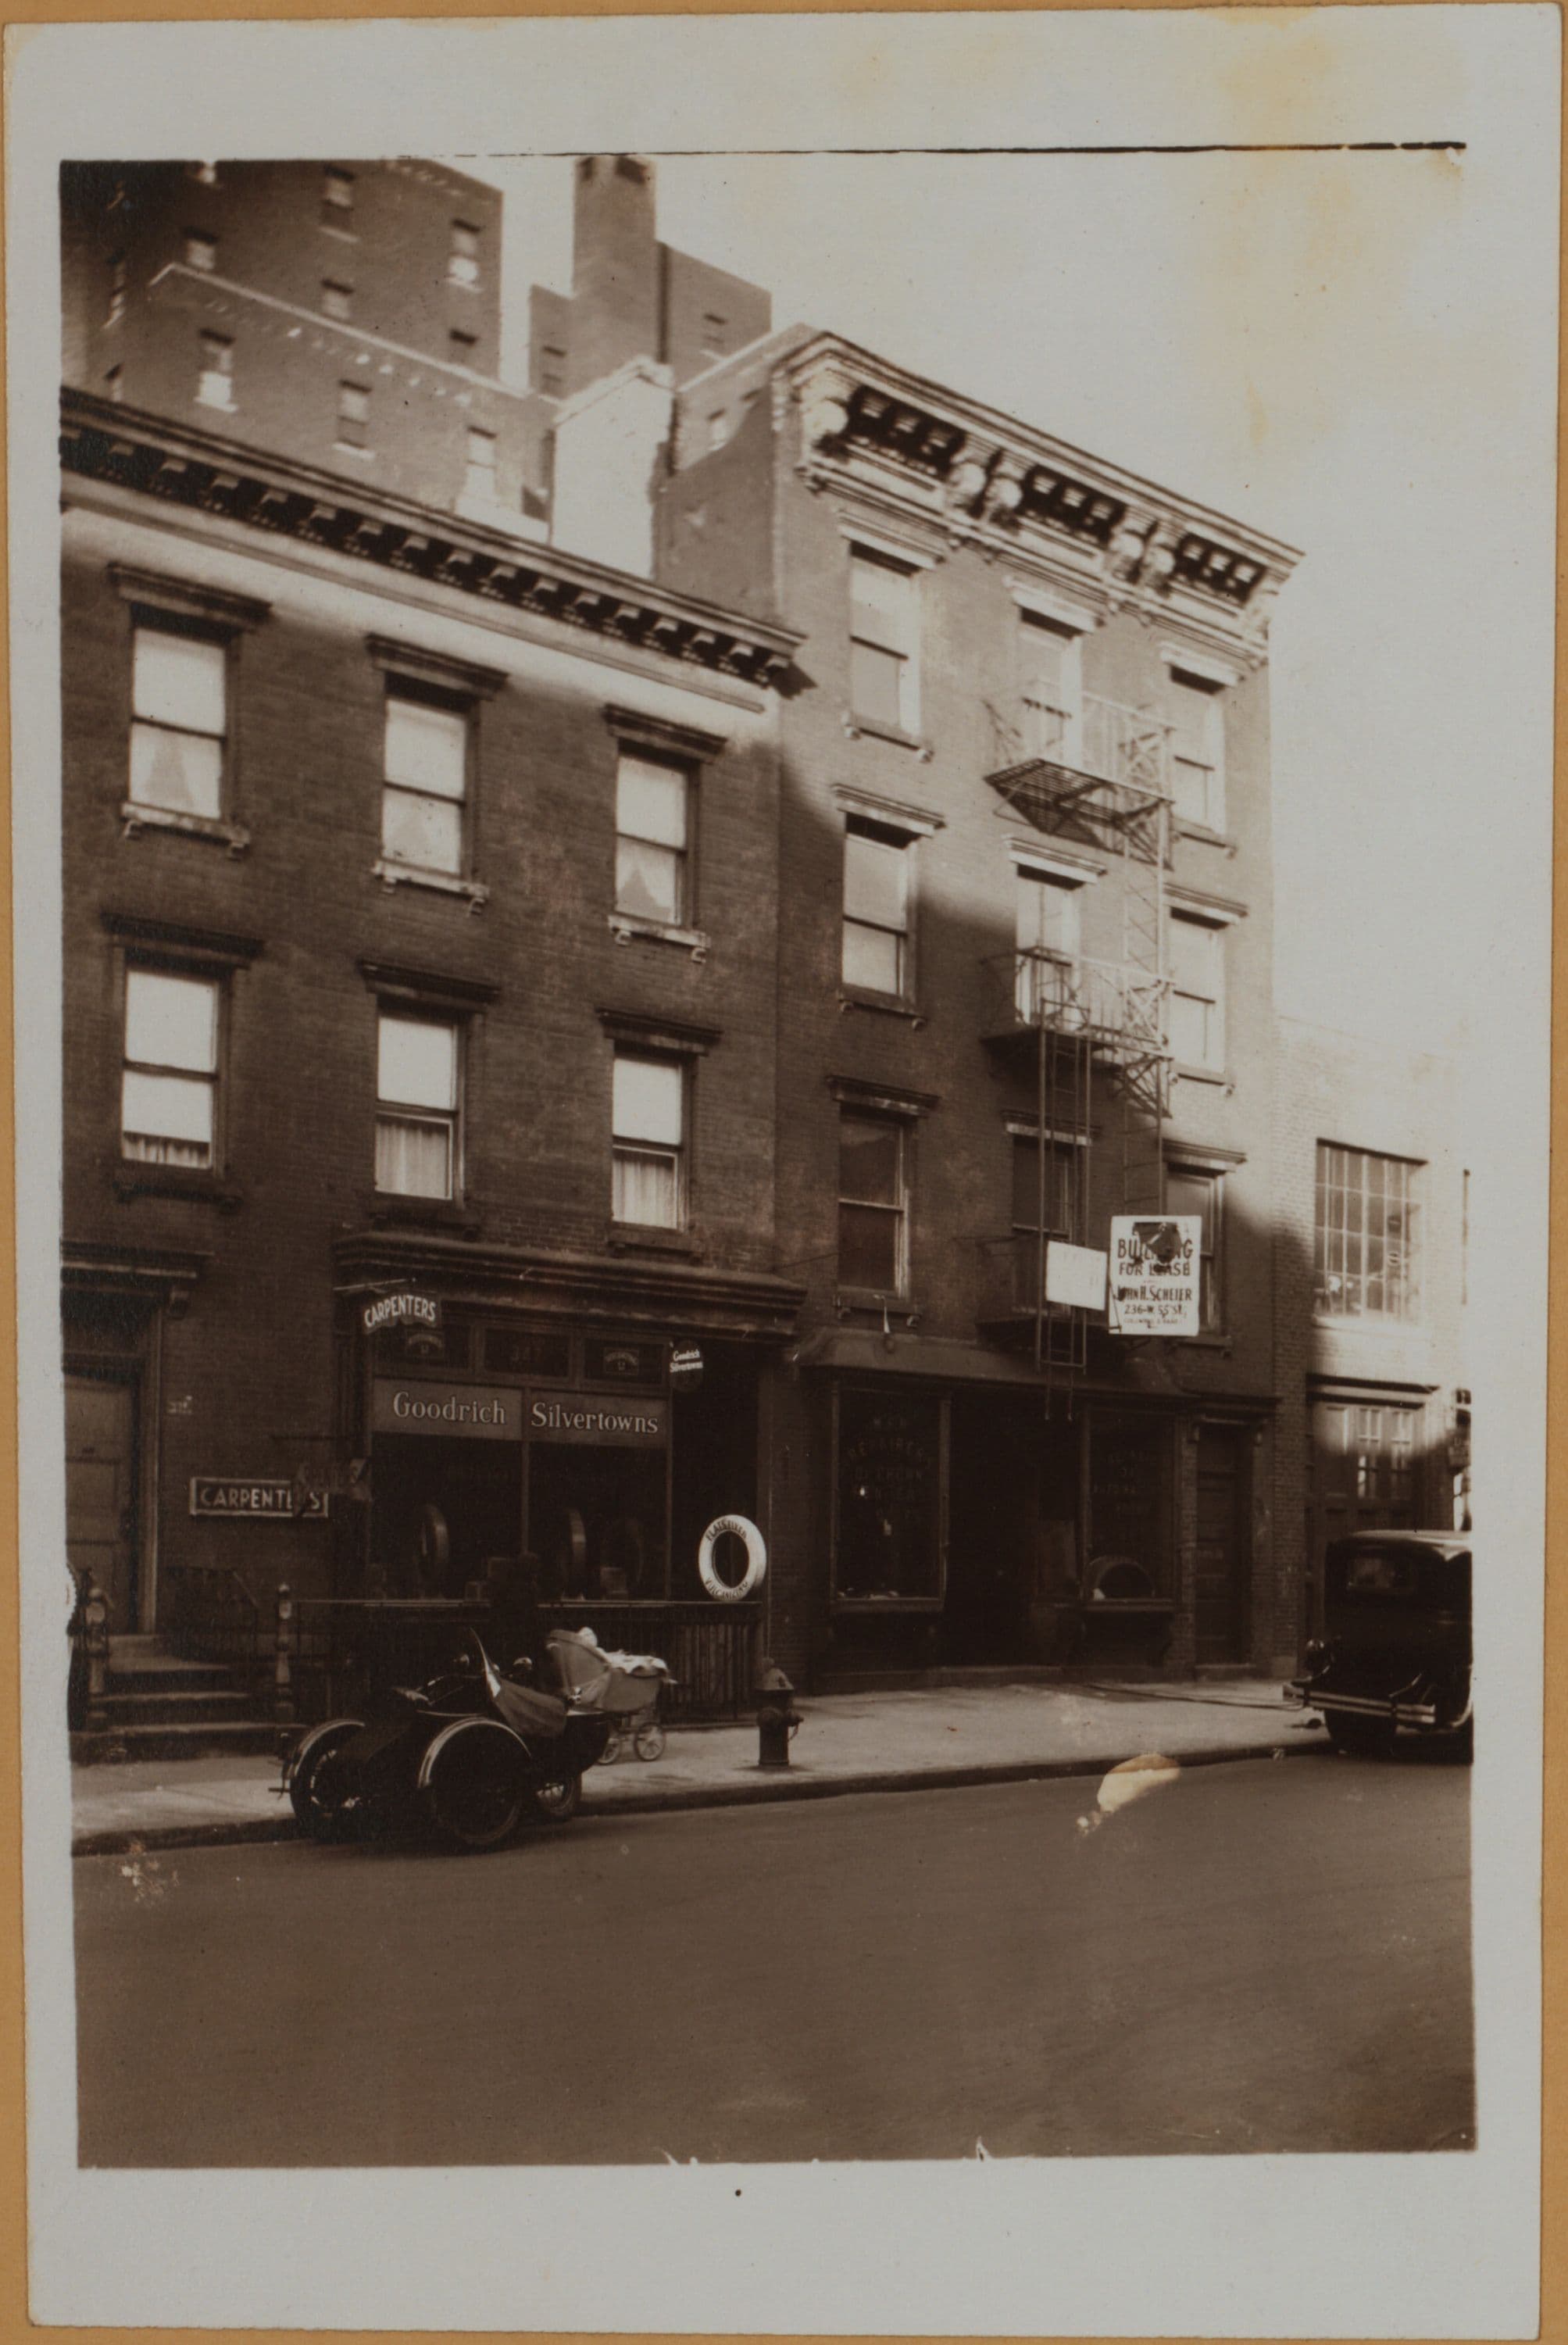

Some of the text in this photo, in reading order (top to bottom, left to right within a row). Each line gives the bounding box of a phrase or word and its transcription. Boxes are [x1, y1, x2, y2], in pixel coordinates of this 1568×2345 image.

[1117, 1239, 1194, 1260] BUILG
[1119, 1263, 1142, 1276] FOR
[1117, 1285, 1138, 1302] JHN
[364, 1295, 436, 1328] CARPENTERS
[393, 1391, 658, 1433] Goodrich Silvertowns
[200, 1488, 320, 1510] CARPENTS
